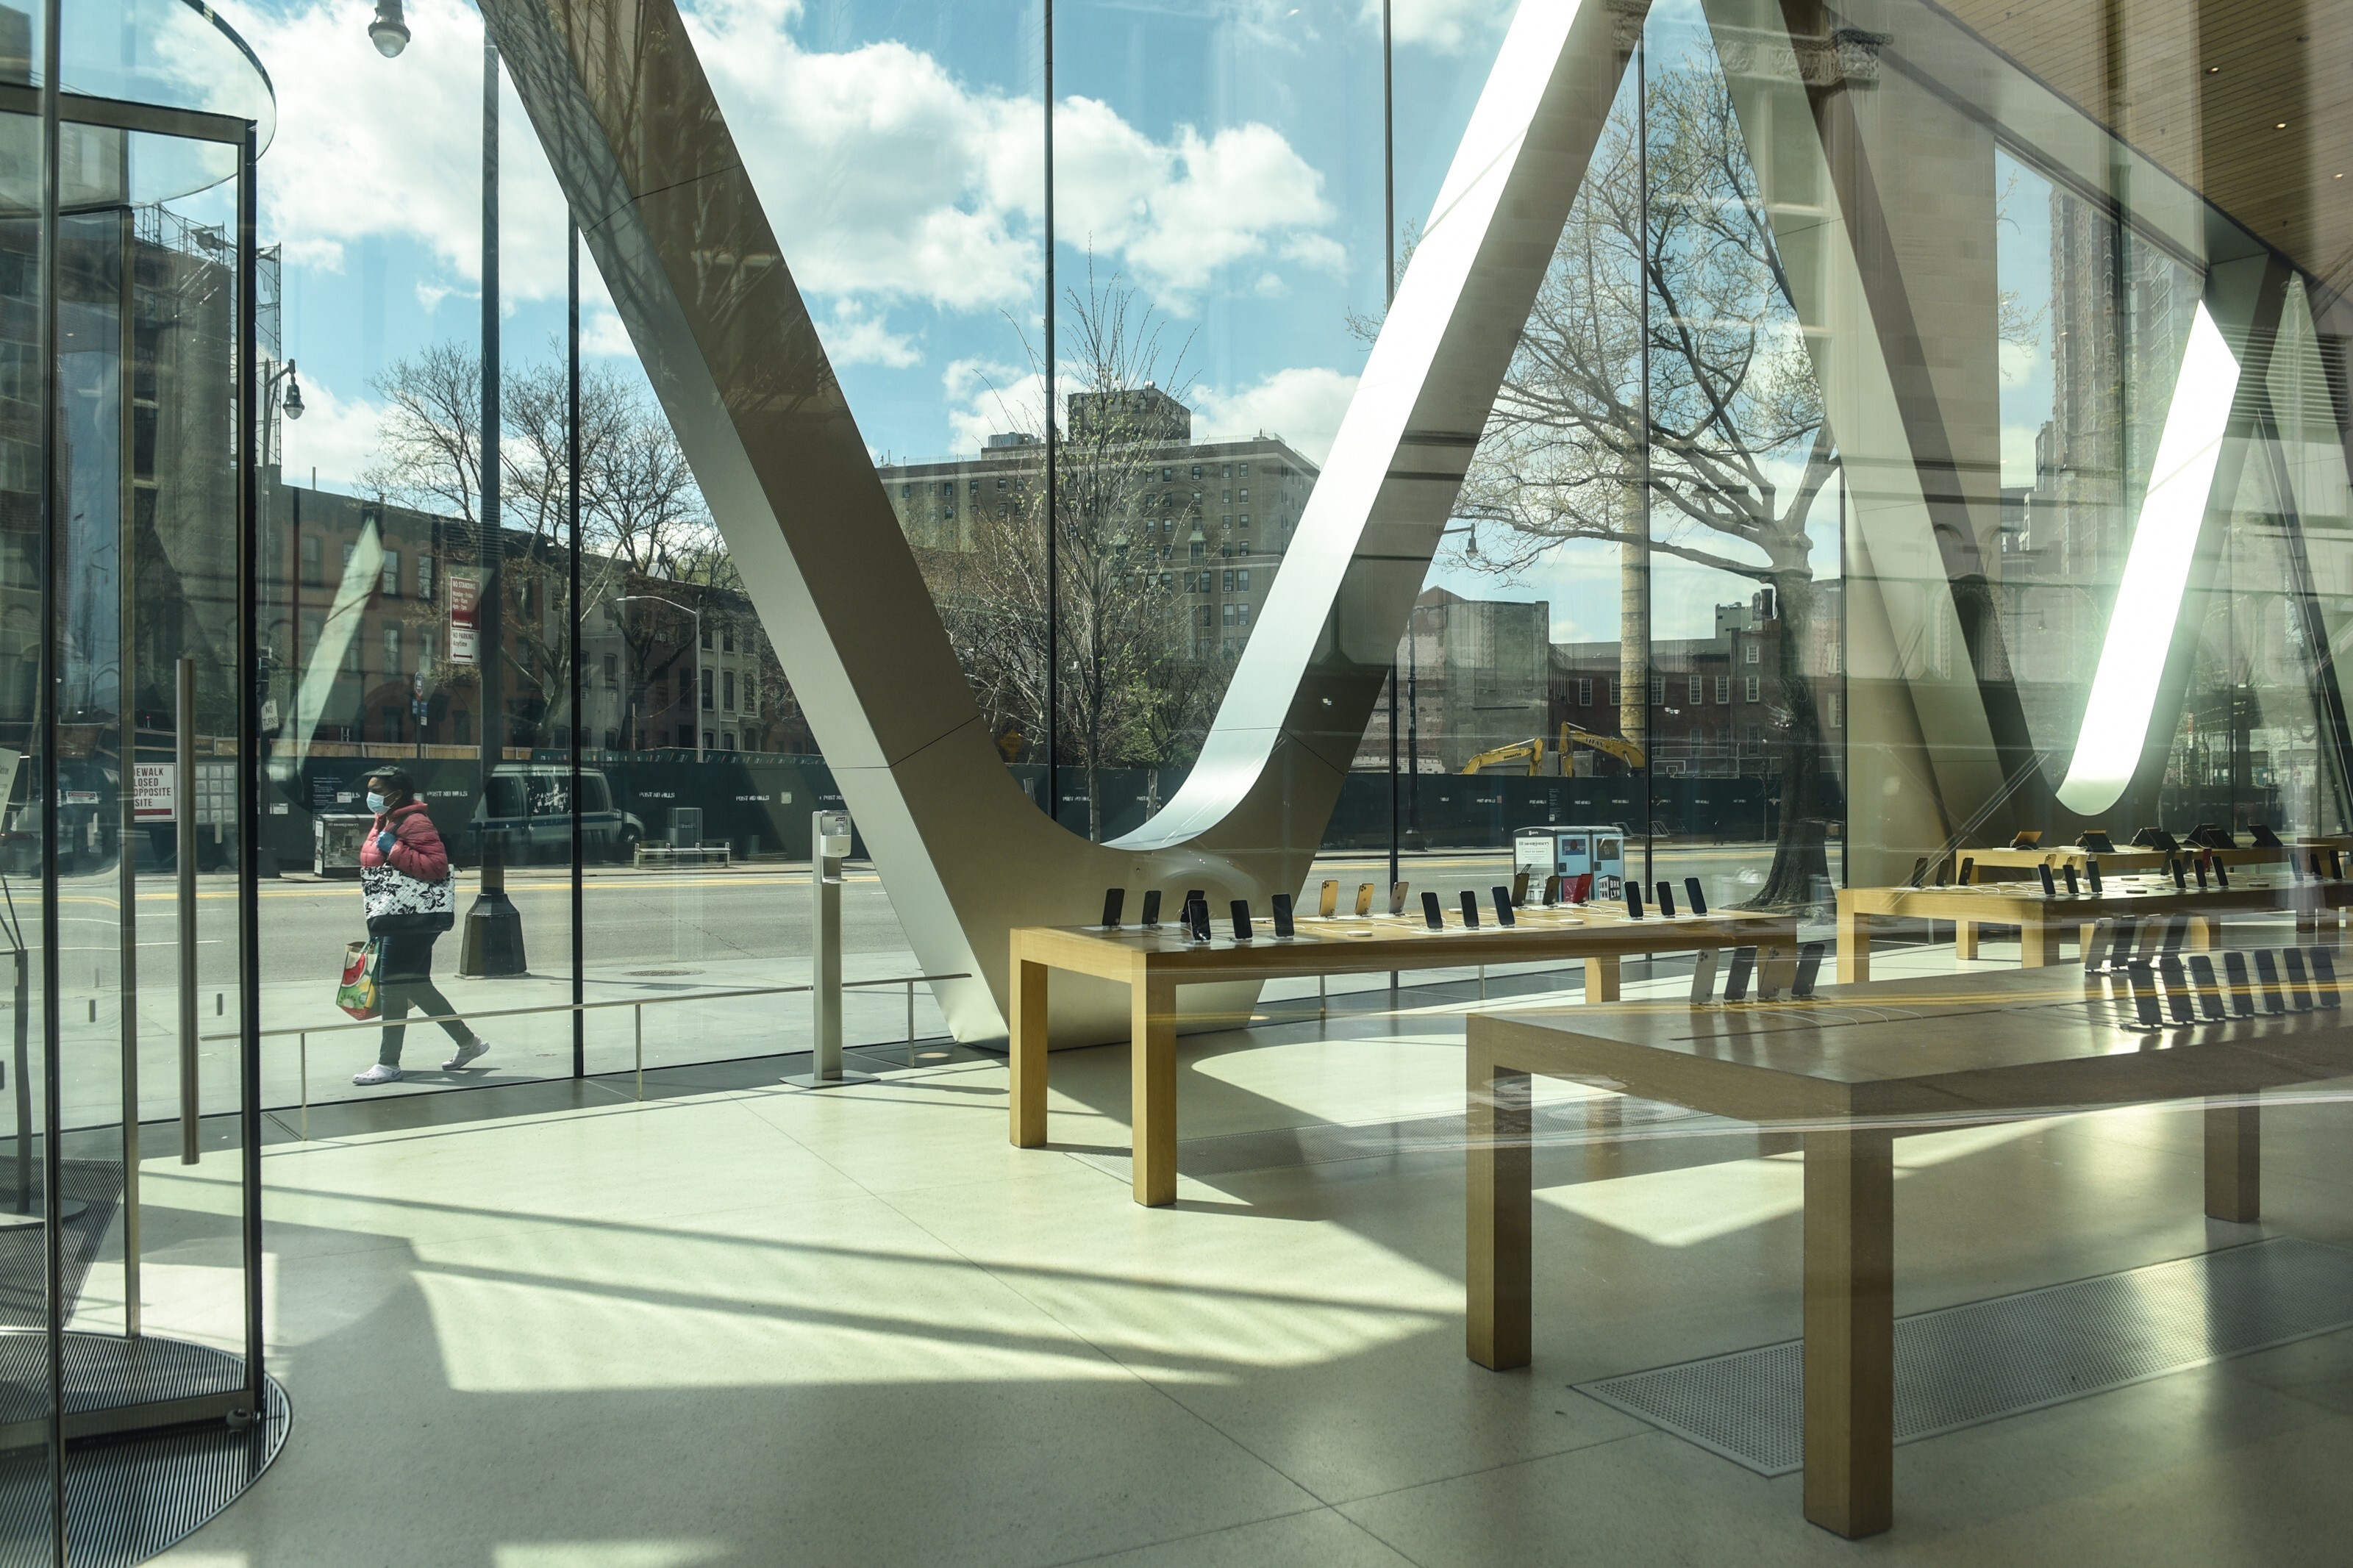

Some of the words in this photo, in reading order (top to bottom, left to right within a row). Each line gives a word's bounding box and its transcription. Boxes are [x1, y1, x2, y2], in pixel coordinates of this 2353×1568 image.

[459, 581, 476, 590] STANDING
[459, 632, 474, 640] PARKING
[453, 640, 468, 648] Anytime
[265, 705, 273, 714] NO
[263, 716, 278, 726] TURNS
[133, 767, 164, 777] EWALK
[134, 778, 159, 787] LOSED
[133, 787, 171, 797] OPPOSITE
[135, 798, 153, 807] SITE
[1610, 880, 1620, 889] BRK
[1599, 890, 1608, 898] TWN
[1610, 889, 1620, 898] LYN
